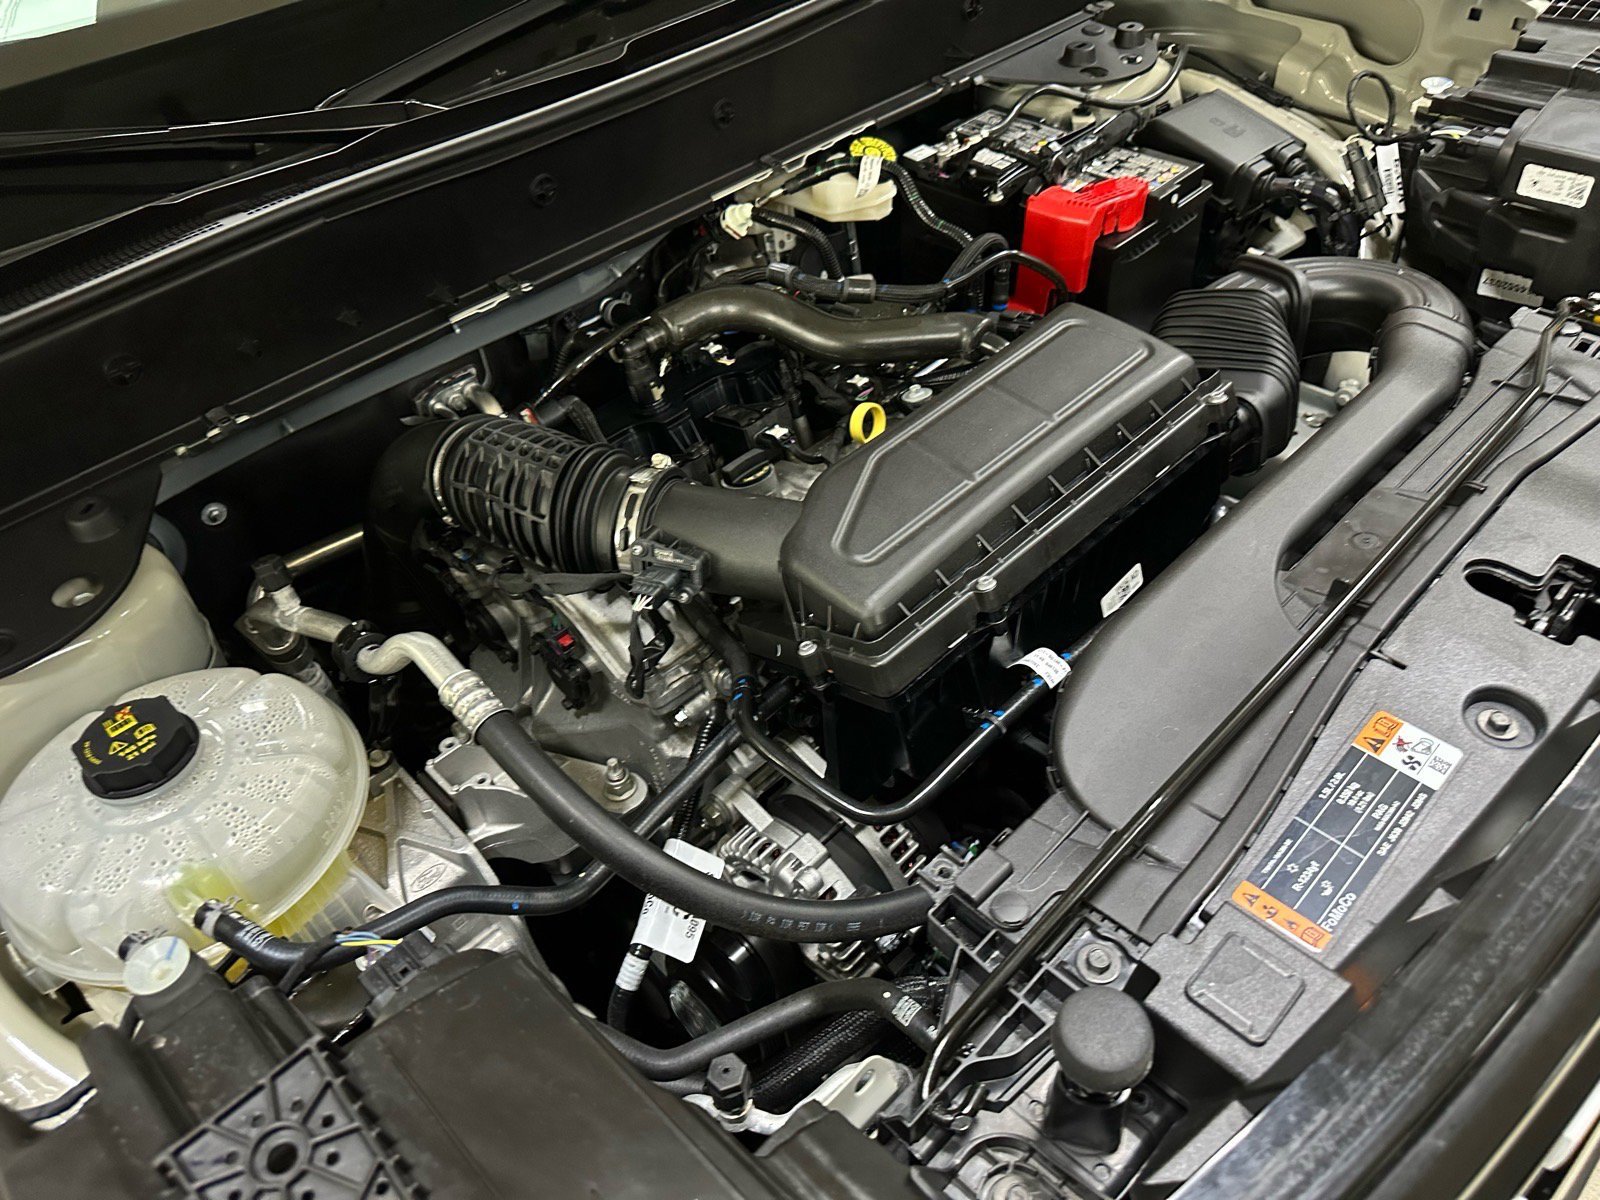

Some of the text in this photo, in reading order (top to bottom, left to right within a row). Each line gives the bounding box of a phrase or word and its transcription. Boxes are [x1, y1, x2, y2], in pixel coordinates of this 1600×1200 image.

[1370, 803, 1389, 819] PAG
[1375, 841, 1393, 856] SAE
[1291, 861, 1320, 892] R-1234yf
[1321, 892, 1357, 932] FoMoCo
